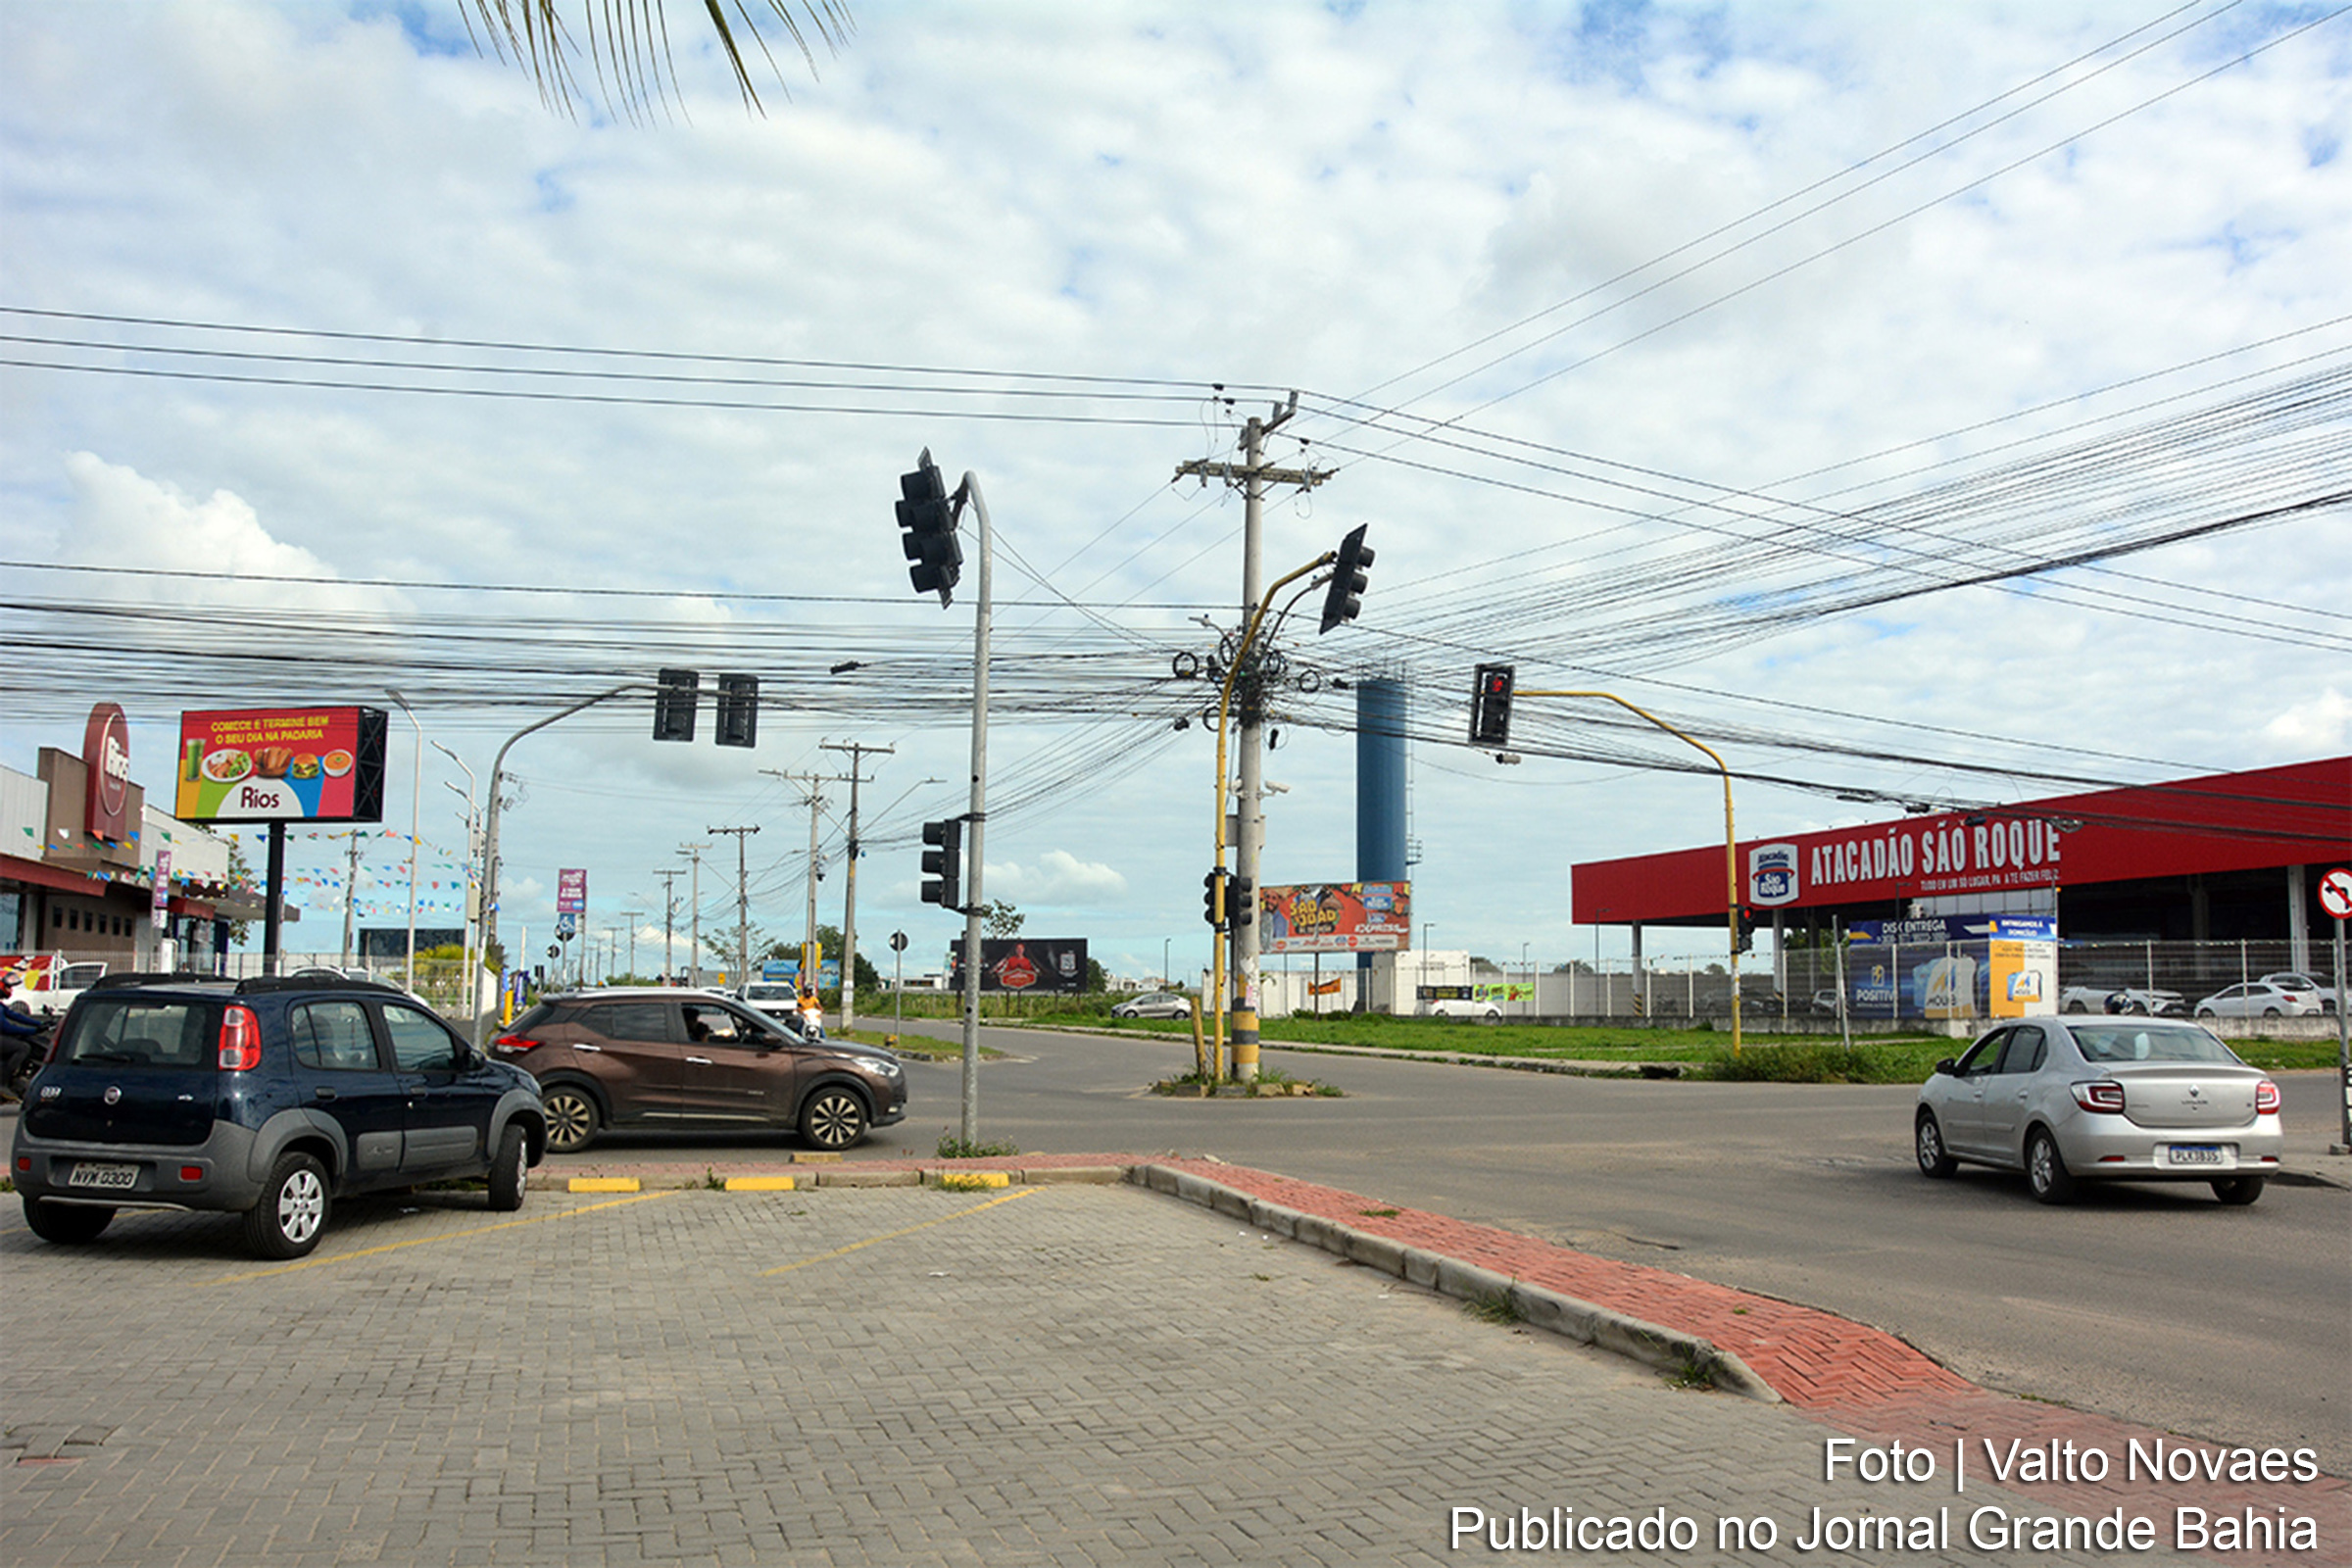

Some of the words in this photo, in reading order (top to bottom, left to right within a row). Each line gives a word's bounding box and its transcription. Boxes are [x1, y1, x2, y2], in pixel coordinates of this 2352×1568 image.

[211, 720, 253, 732] COMECE
[254, 718, 262, 730] E
[263, 717, 306, 729] TERMINE
[307, 715, 329, 727] BEM
[216, 733, 224, 745] O
[224, 732, 245, 744] SEU
[246, 731, 264, 743] DIA
[265, 730, 279, 742] NA
[280, 728, 323, 741] PADARIA
[240, 786, 280, 808] Rios
[1811, 827, 1914, 886] ATACADÃO
[1922, 820, 1966, 874] SÃO
[1974, 819, 2061, 871] ROQUE
[1904, 918, 1947, 933] ENTREGA
